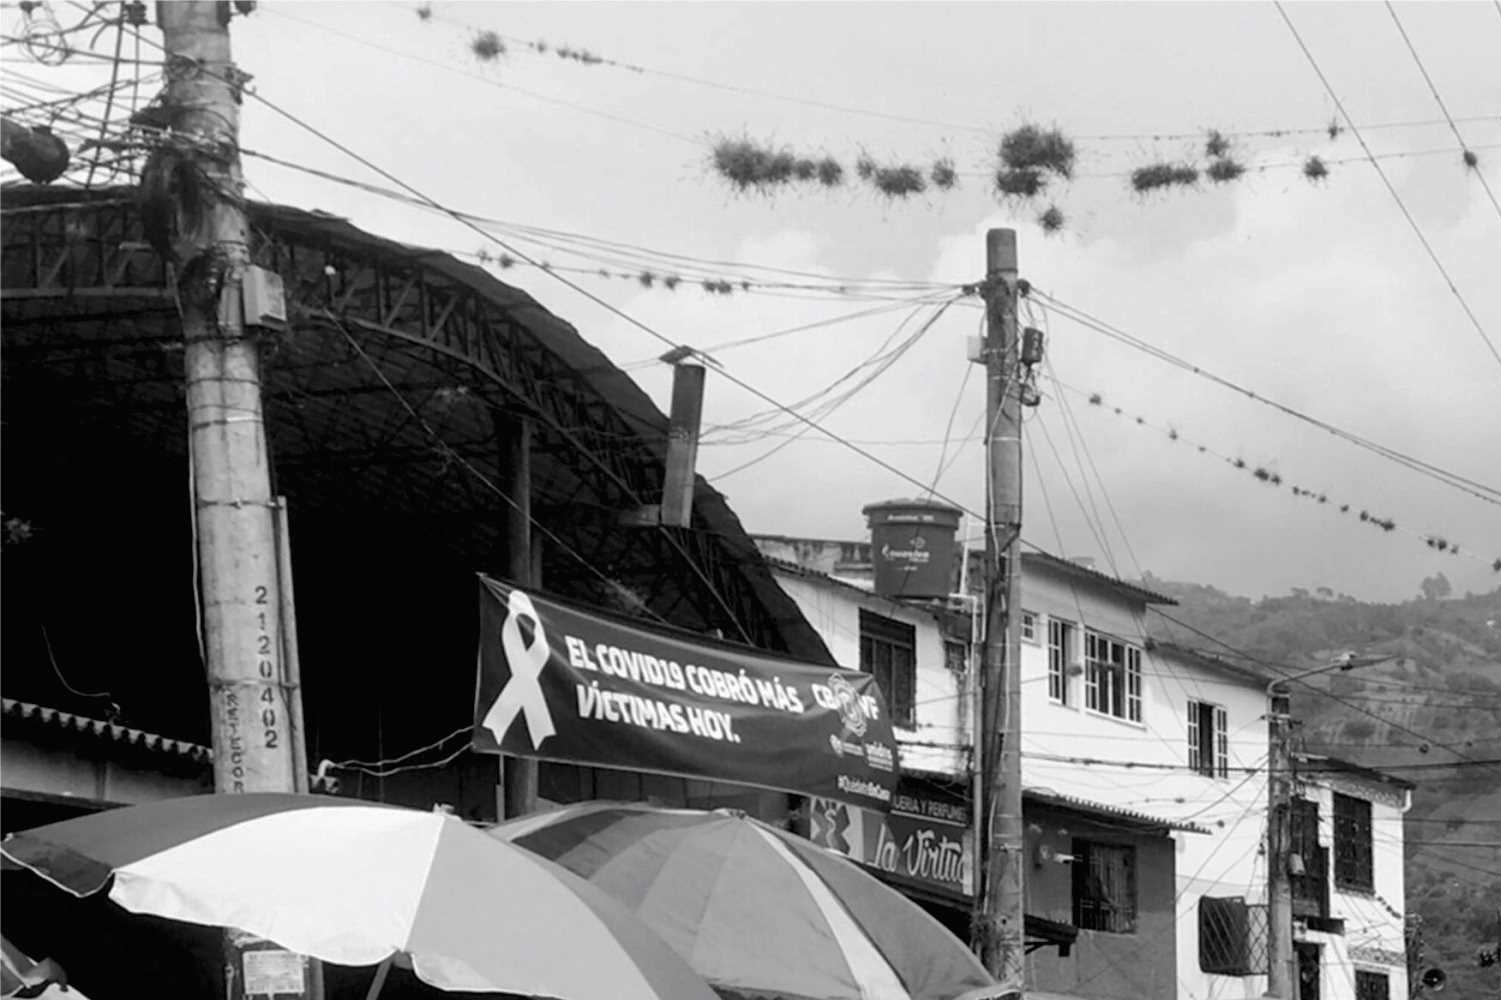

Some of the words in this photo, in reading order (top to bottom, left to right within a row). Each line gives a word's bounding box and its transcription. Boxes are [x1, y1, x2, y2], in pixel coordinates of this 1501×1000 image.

[565, 635, 598, 671] EL
[596, 644, 686, 690] COVID19
[685, 669, 759, 705] COBRÓ
[755, 676, 804, 714] MÁS
[576, 681, 690, 734] VÍCTIMAS
[687, 706, 741, 743] HOY.
